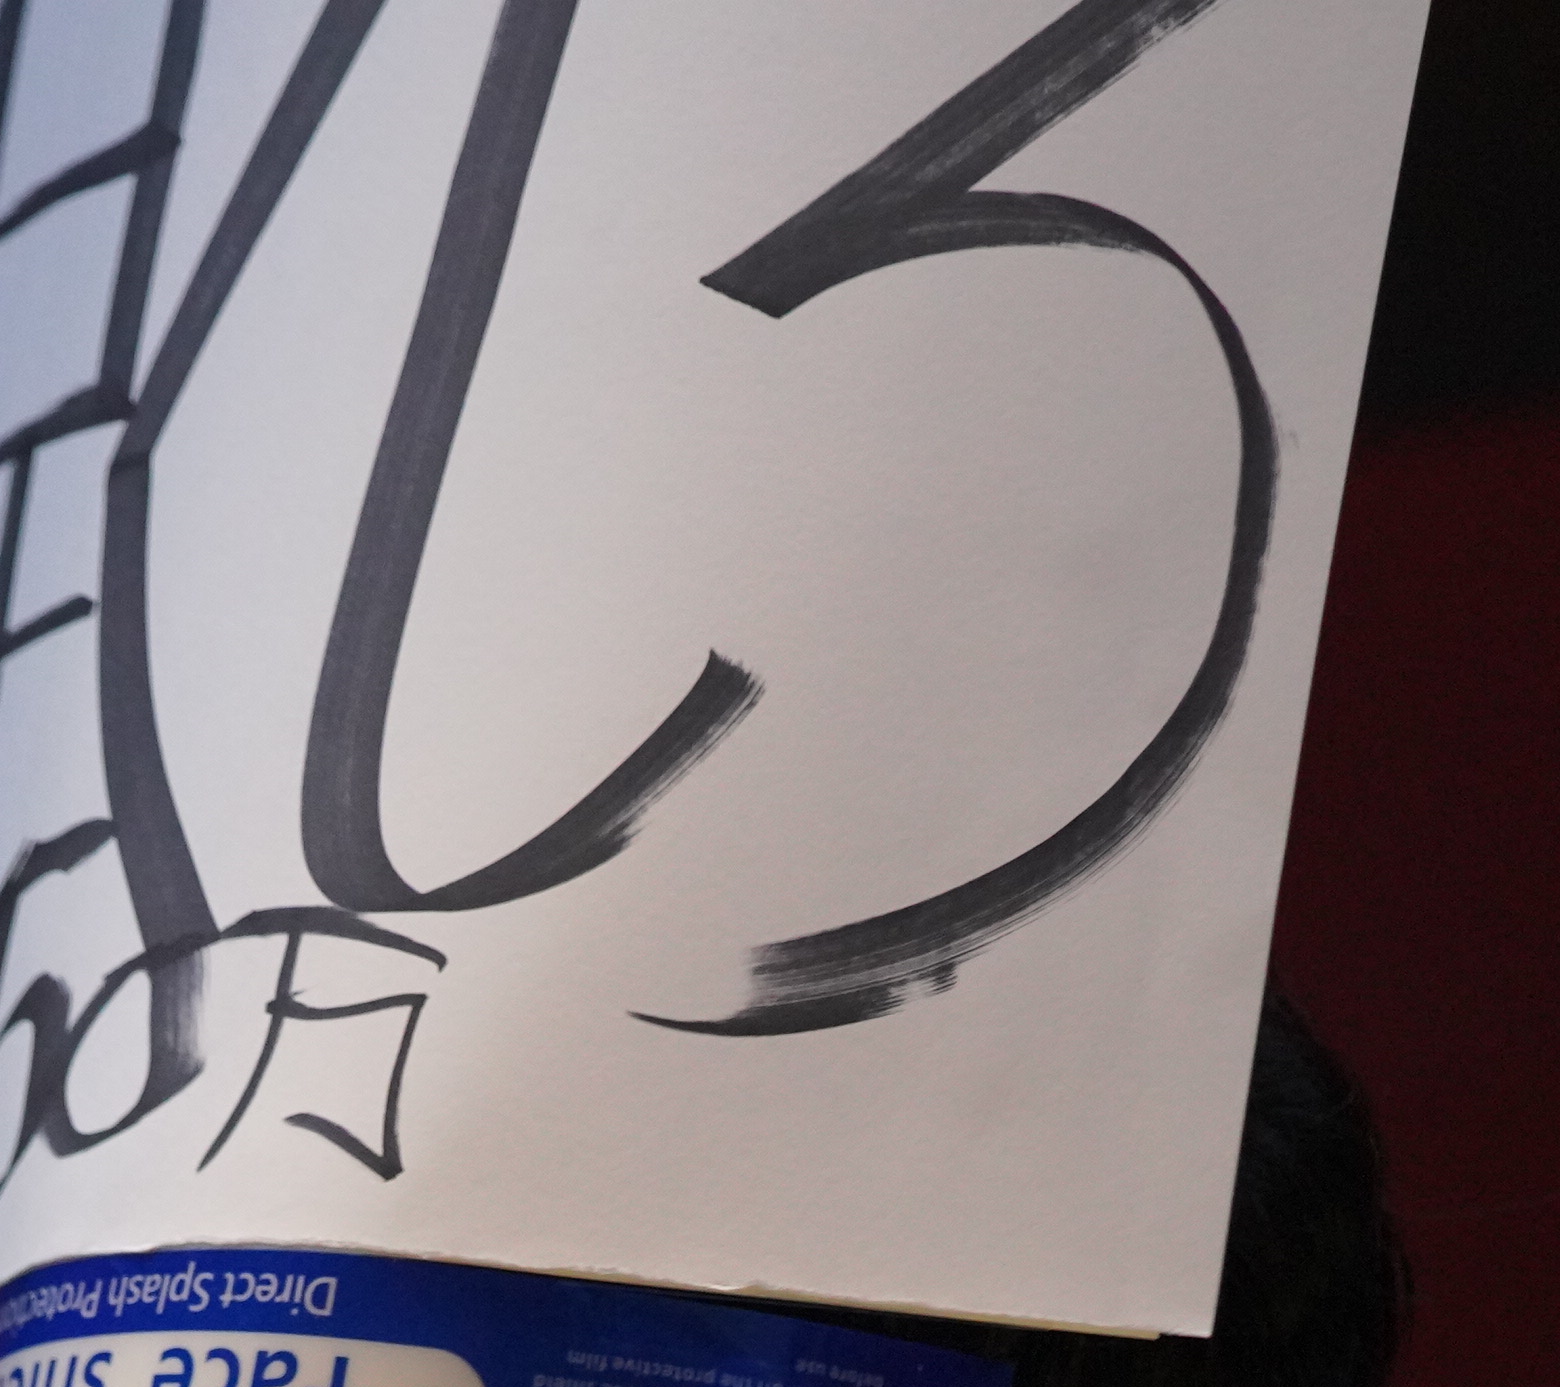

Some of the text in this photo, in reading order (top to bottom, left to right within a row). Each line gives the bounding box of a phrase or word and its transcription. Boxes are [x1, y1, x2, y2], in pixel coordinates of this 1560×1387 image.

[107, 1264, 214, 1316] Splash
[219, 1272, 338, 1317] Direct
[567, 1348, 608, 1372] film
[612, 1355, 716, 1385] protective
